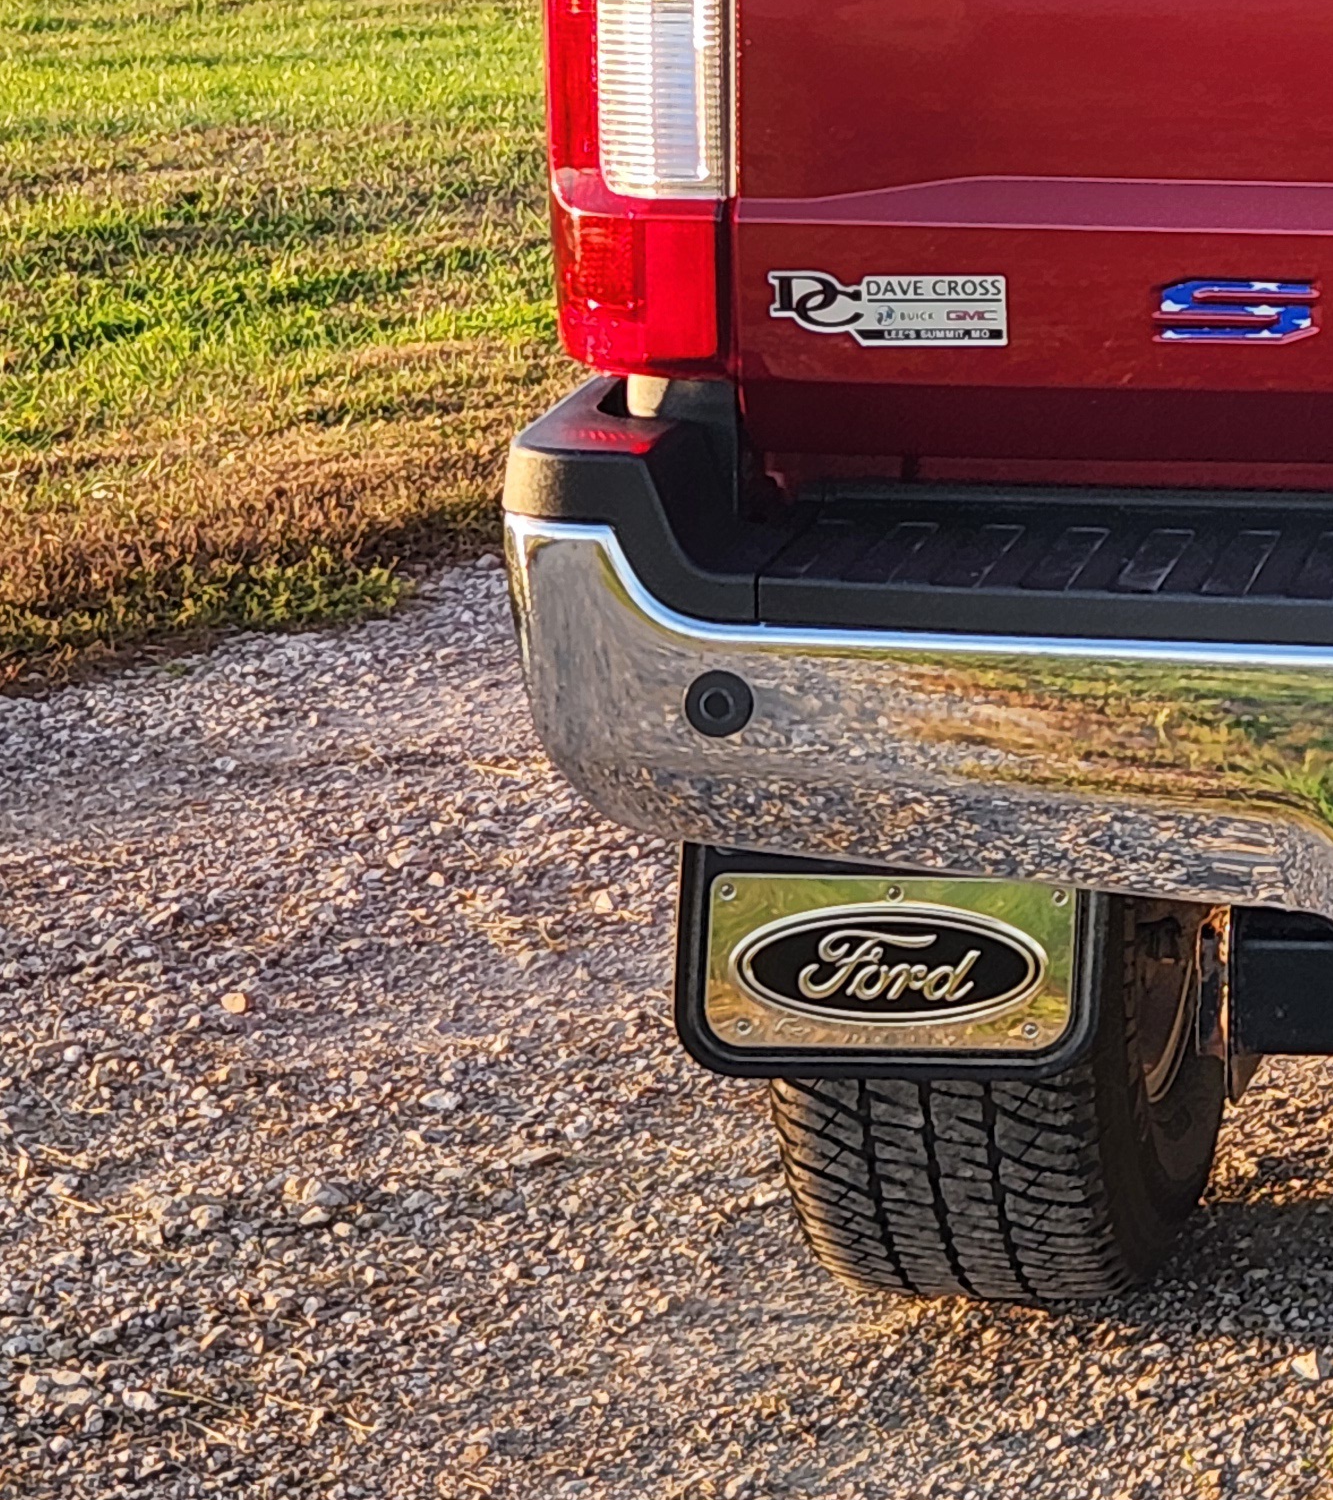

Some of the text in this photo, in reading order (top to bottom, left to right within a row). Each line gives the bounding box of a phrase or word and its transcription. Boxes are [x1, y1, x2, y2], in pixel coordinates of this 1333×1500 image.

[866, 280, 1002, 296] DAVE CROSS
[899, 309, 999, 321] BUICK GMC
[971, 329, 990, 339] MO
[798, 929, 982, 1002] Ford
